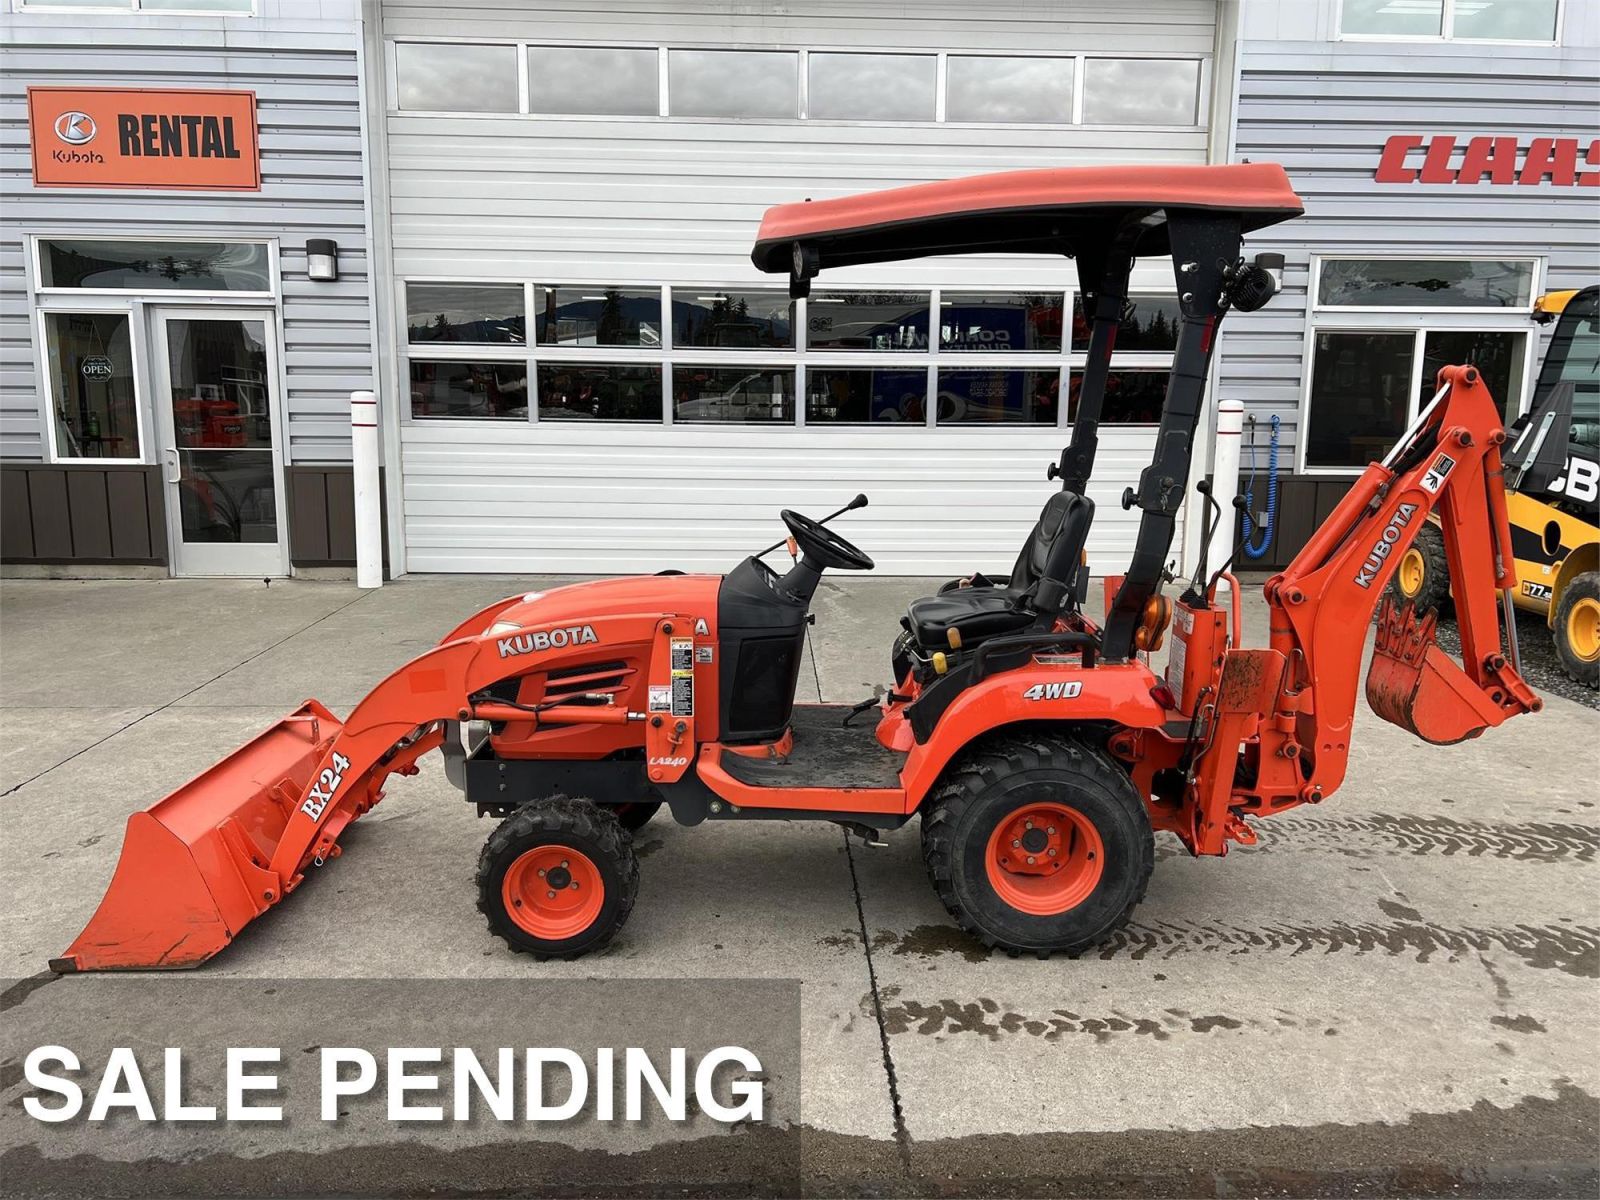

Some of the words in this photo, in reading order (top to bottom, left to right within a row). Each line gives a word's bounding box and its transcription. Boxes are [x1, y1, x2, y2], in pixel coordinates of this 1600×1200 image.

[117, 113, 241, 159] RENTAL
[52, 150, 104, 164] Kubota
[83, 365, 111, 374] OPEN
[1353, 502, 1420, 590] KUBOTA
[497, 625, 599, 658] KUBOTA
[1023, 681, 1083, 701] 4WD
[650, 756, 688, 767] LA240
[300, 751, 351, 824] BX24
